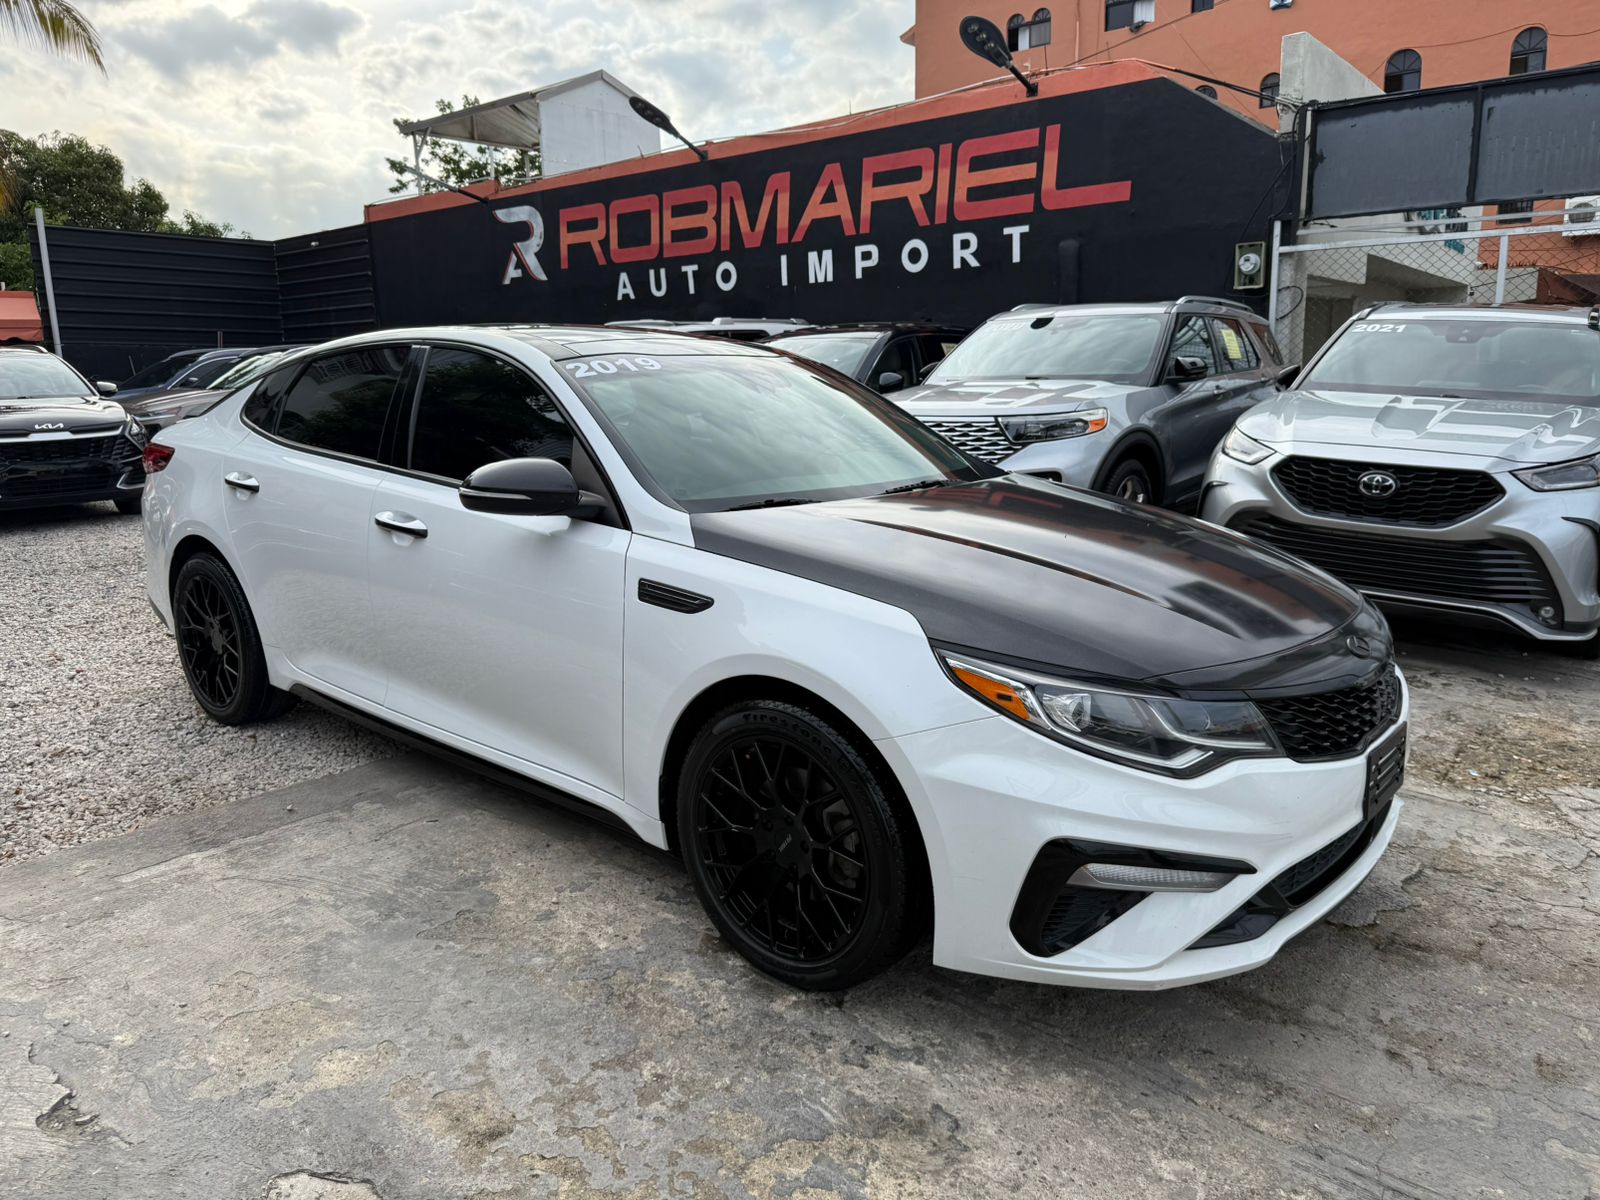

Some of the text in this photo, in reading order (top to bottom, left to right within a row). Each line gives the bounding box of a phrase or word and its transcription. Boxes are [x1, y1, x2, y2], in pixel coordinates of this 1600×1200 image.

[559, 124, 1132, 270] ROBMARIEL
[616, 225, 1030, 301] AUTO IMPORT
[1351, 323, 1407, 333] 2021
[566, 357, 662, 378] 2019
